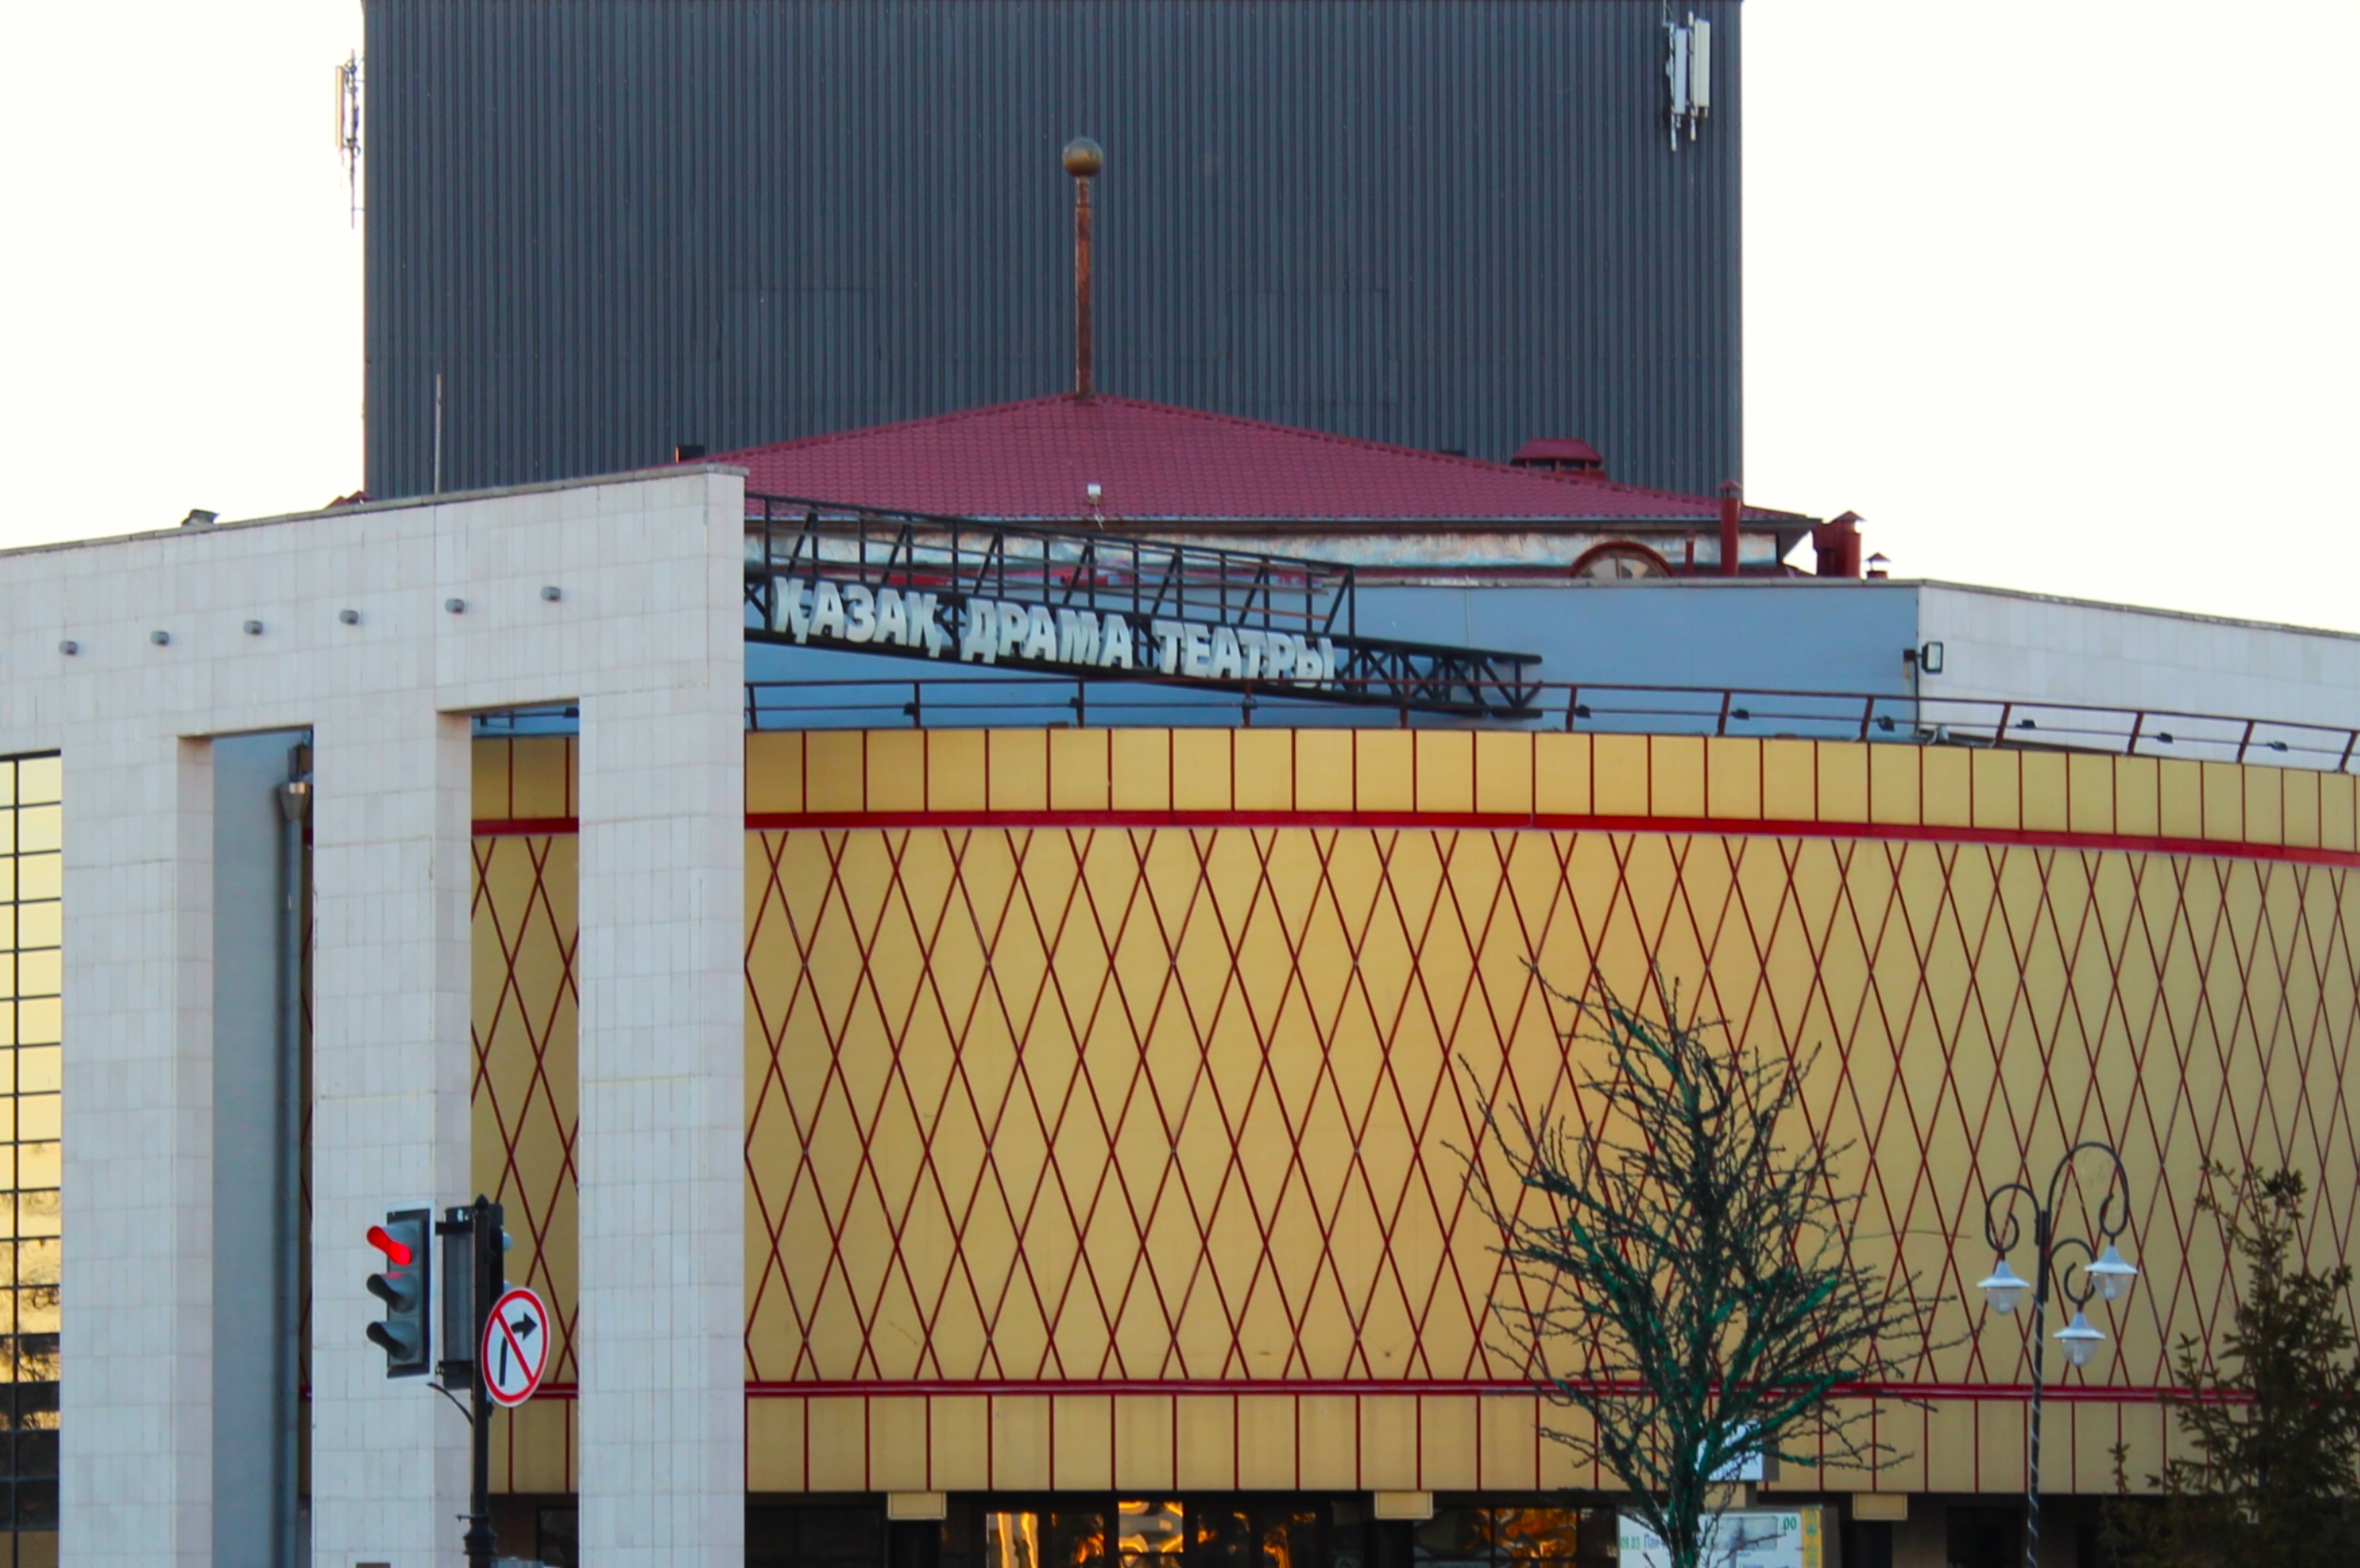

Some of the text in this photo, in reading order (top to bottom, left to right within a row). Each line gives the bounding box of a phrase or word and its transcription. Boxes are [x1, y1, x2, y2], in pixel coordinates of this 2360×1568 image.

[772, 576, 1335, 690] ҚАЗАҚ ДРАМА ТЕАТРЫ
